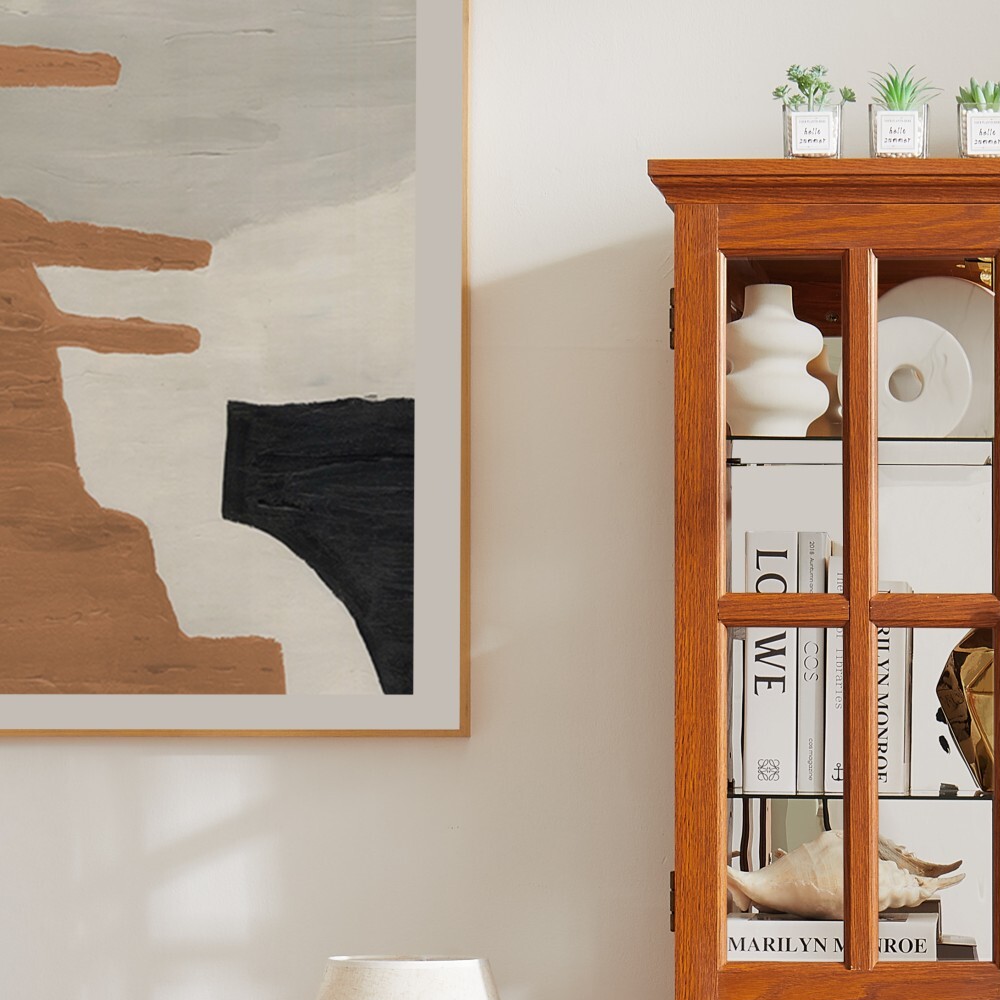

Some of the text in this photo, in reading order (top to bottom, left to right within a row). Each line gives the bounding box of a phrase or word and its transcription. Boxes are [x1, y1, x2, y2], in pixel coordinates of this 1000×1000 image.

[754, 549, 788, 696] LOWE
[803, 641, 819, 682] COS
[728, 936, 827, 953] MARILYN
